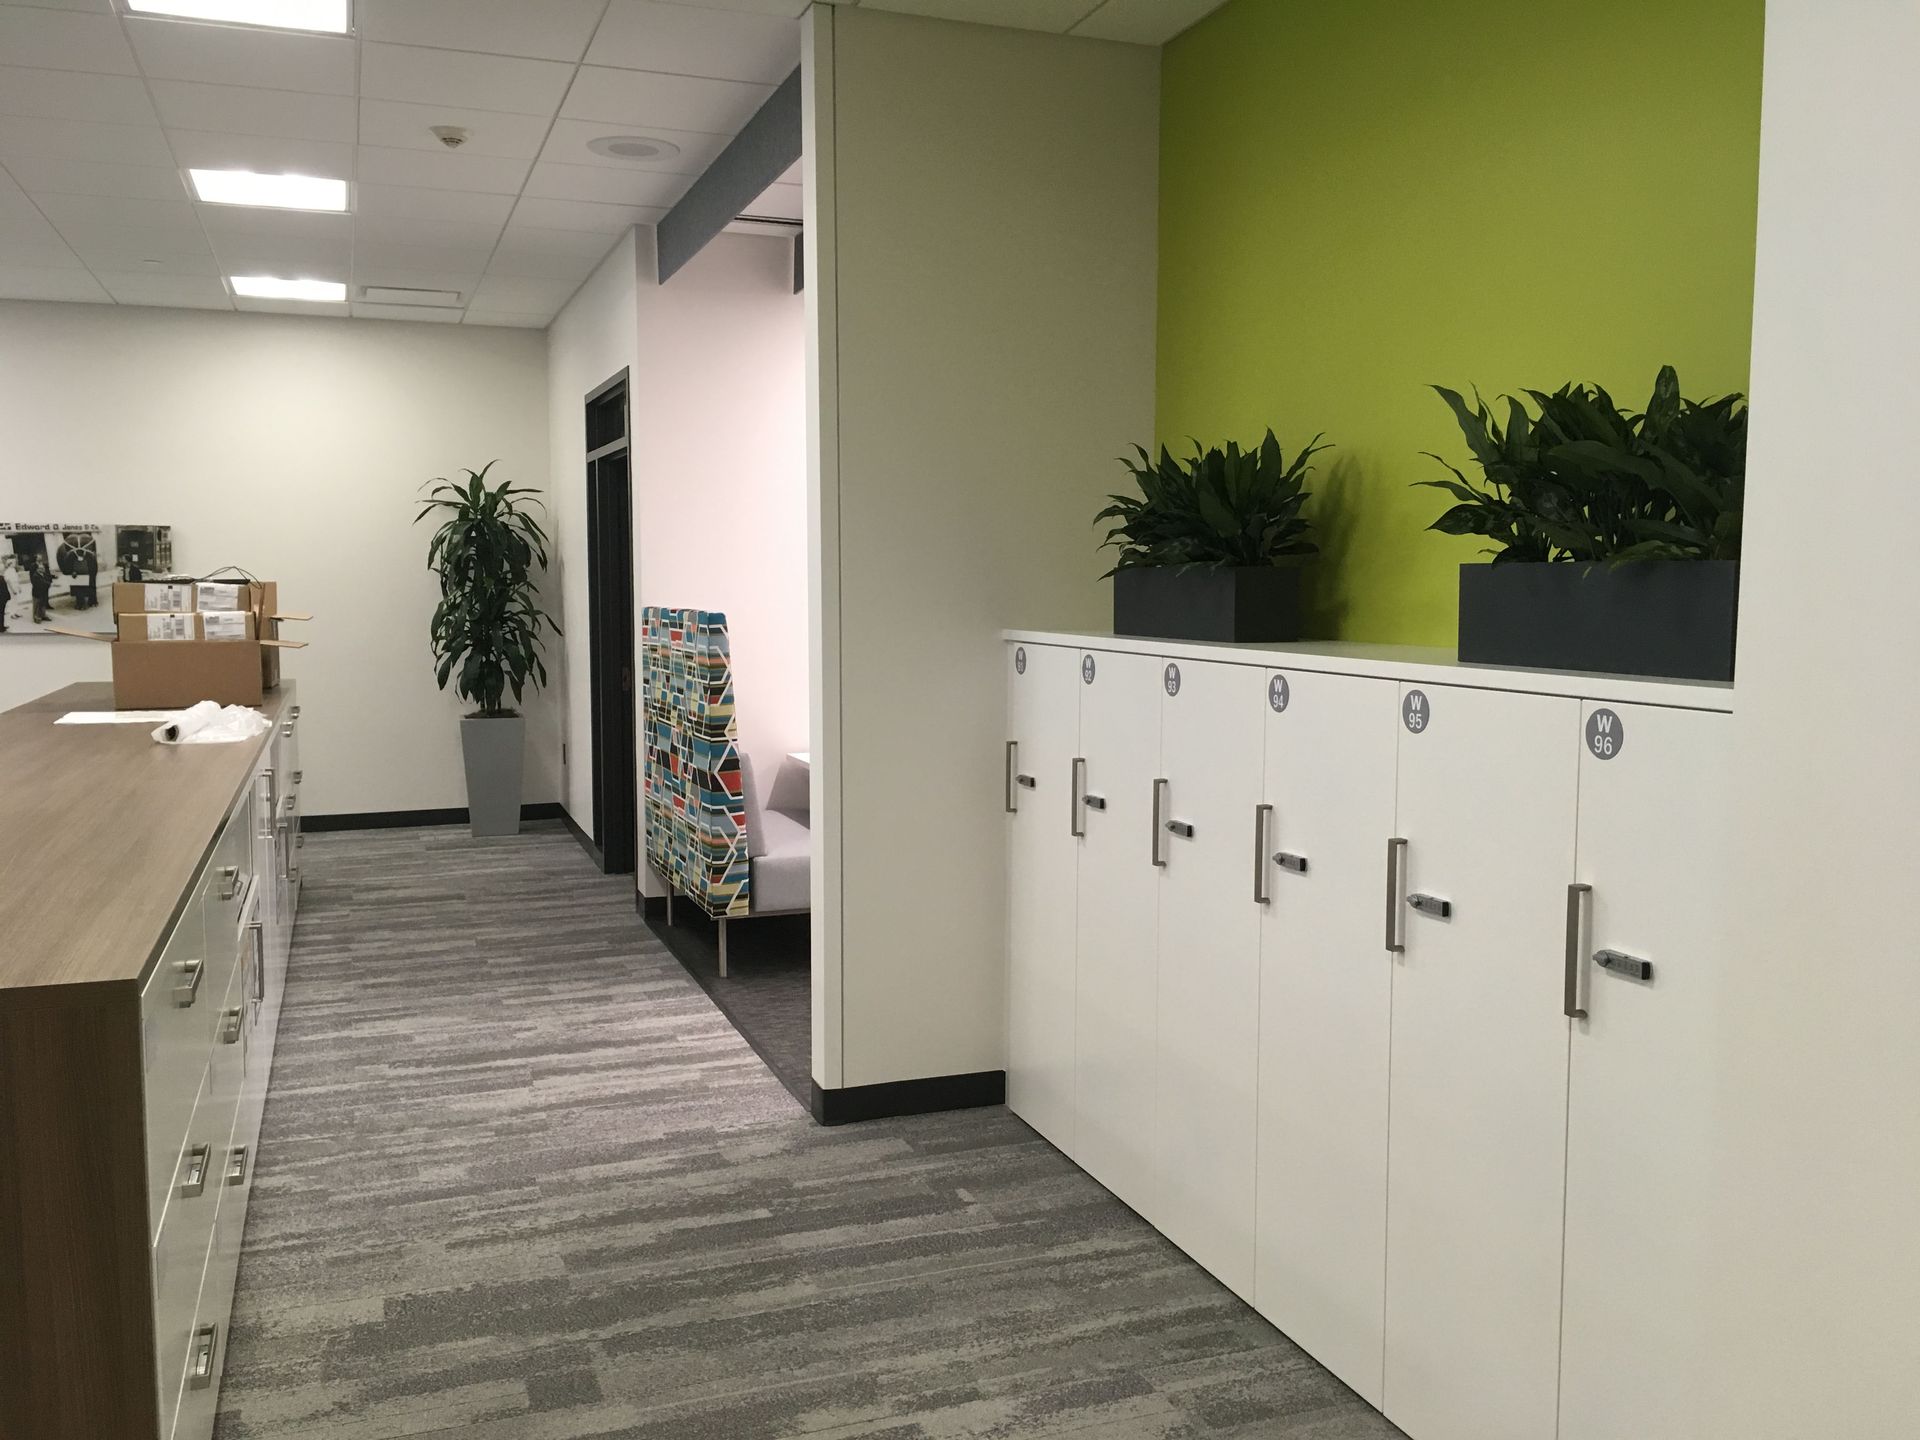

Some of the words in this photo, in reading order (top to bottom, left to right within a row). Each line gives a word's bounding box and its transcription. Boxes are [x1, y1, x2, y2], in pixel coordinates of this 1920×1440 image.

[1085, 657, 1092, 668] W
[1084, 670, 1092, 681] 92
[1168, 667, 1176, 678] W
[1167, 681, 1176, 693] 93
[1273, 679, 1283, 692] W
[1273, 694, 1284, 709] 94
[1410, 695, 1423, 711] W
[1408, 712, 1422, 729] 95
[1596, 714, 1613, 733] W
[1594, 735, 1613, 755] 96
